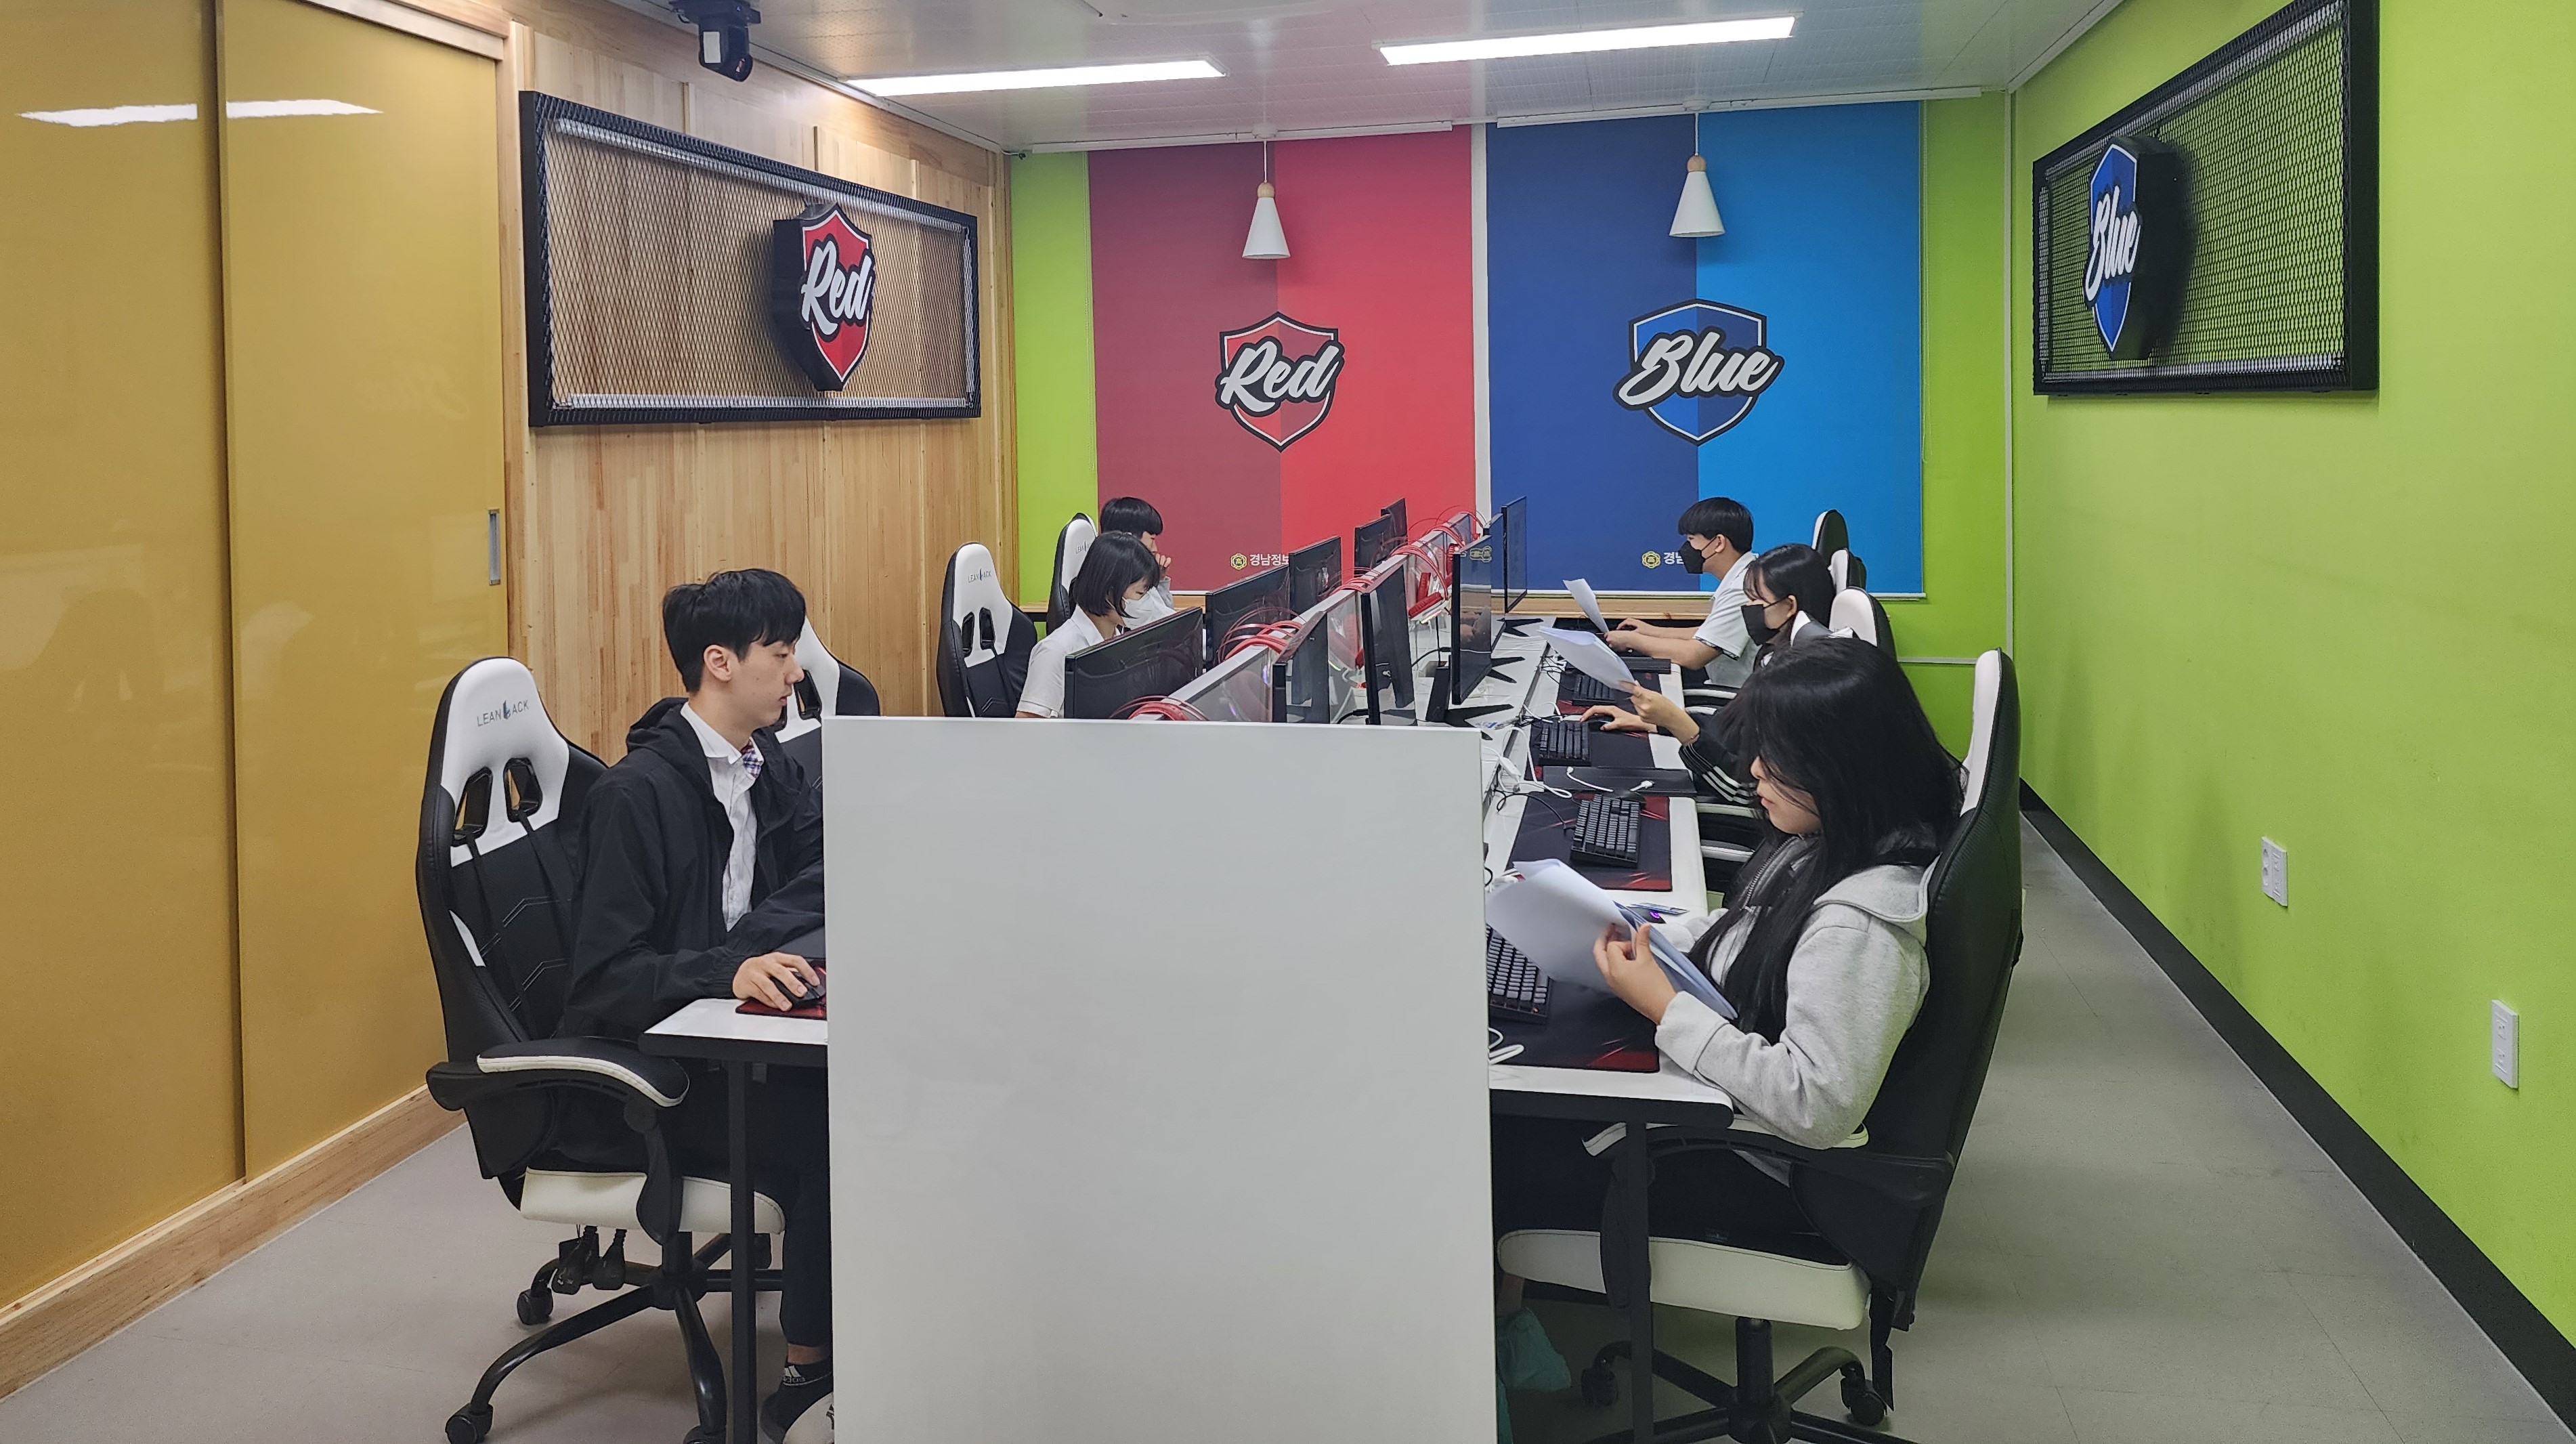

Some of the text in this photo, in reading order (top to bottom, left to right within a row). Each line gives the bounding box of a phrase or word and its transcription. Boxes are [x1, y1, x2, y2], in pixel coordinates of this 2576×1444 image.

[2085, 185, 2141, 301] Blue
[800, 240, 873, 335] Red
[1220, 340, 1340, 413] Red
[1618, 331, 1780, 406] Blue
